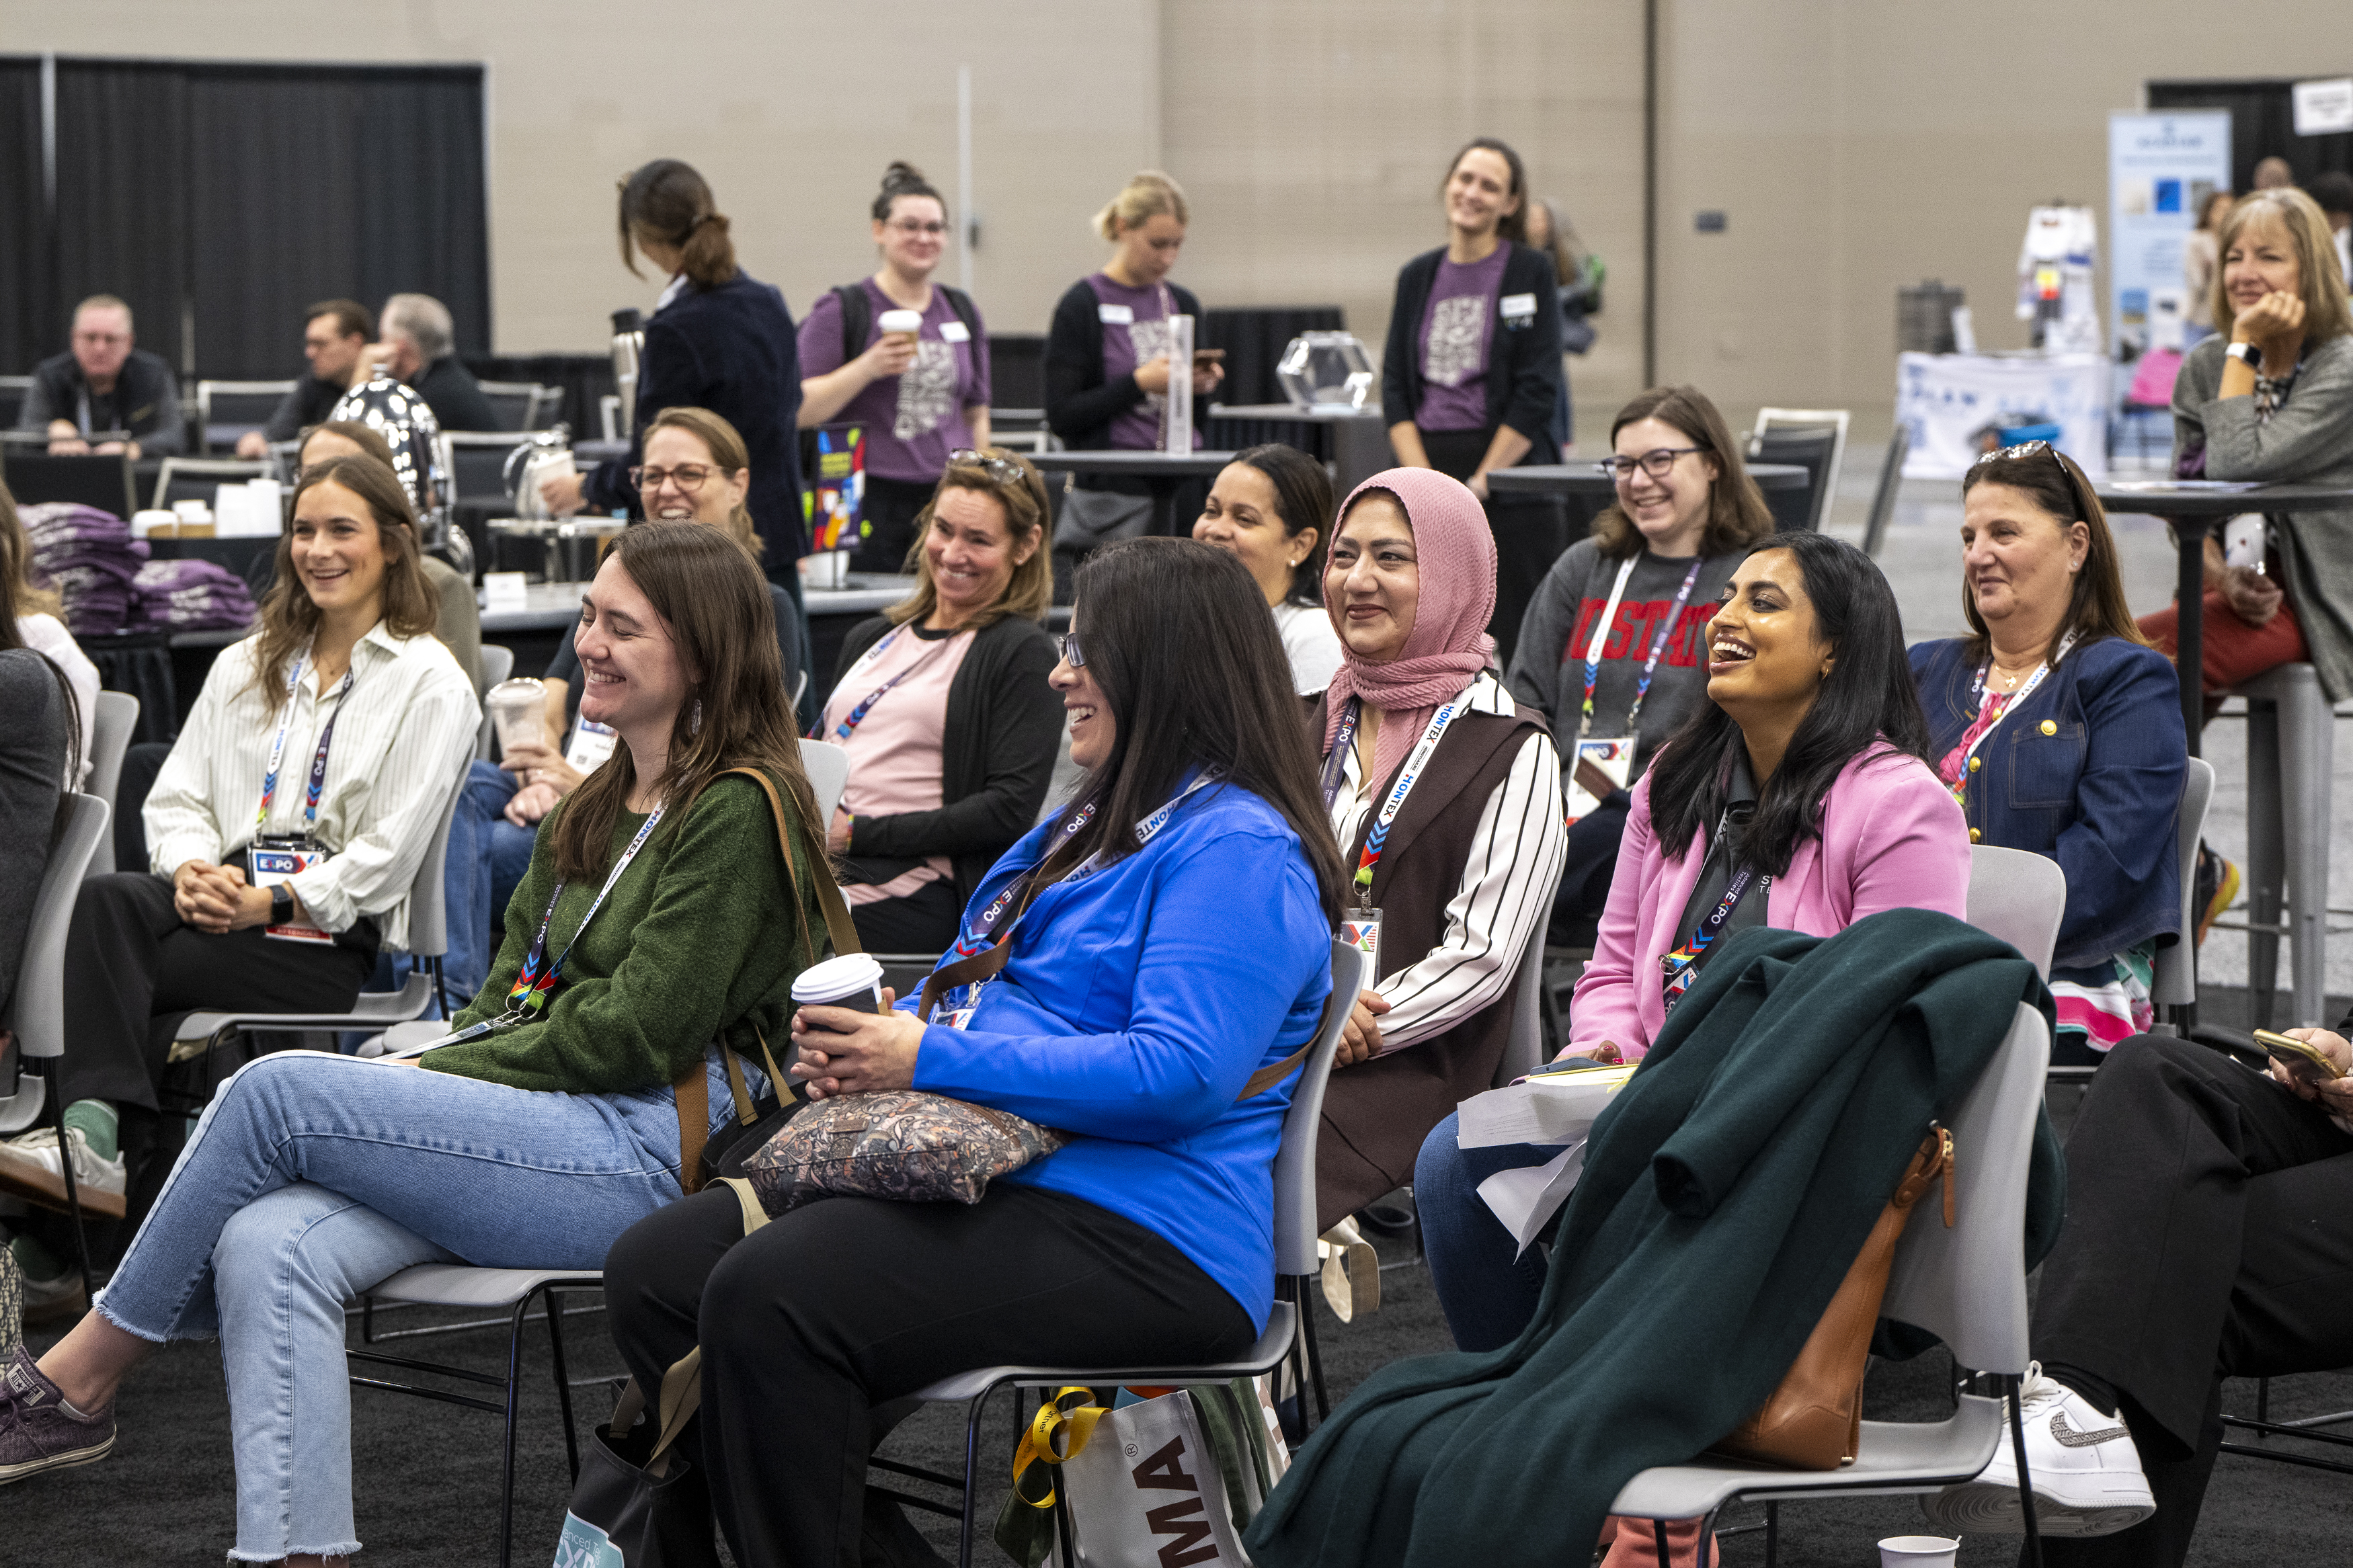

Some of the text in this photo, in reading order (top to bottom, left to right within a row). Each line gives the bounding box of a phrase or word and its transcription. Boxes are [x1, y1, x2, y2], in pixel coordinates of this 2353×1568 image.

[1339, 714, 1355, 742] EXPO
[1427, 705, 1454, 744] HONTEX
[313, 746, 328, 776] EXPO
[1384, 774, 1414, 817] HONTEX
[1067, 803, 1095, 832] EXPO
[1136, 802, 1175, 840] HONTE
[626, 810, 661, 858] HONTEX
[260, 858, 294, 872] EXPO
[1730, 871, 1747, 891] Textiles
[1734, 873, 1750, 895] Advanced
[984, 891, 1012, 922] EXPO
[1711, 891, 1737, 924] EXPO
[537, 908, 552, 944] EXPO
[1039, 1409, 1061, 1433] artner
